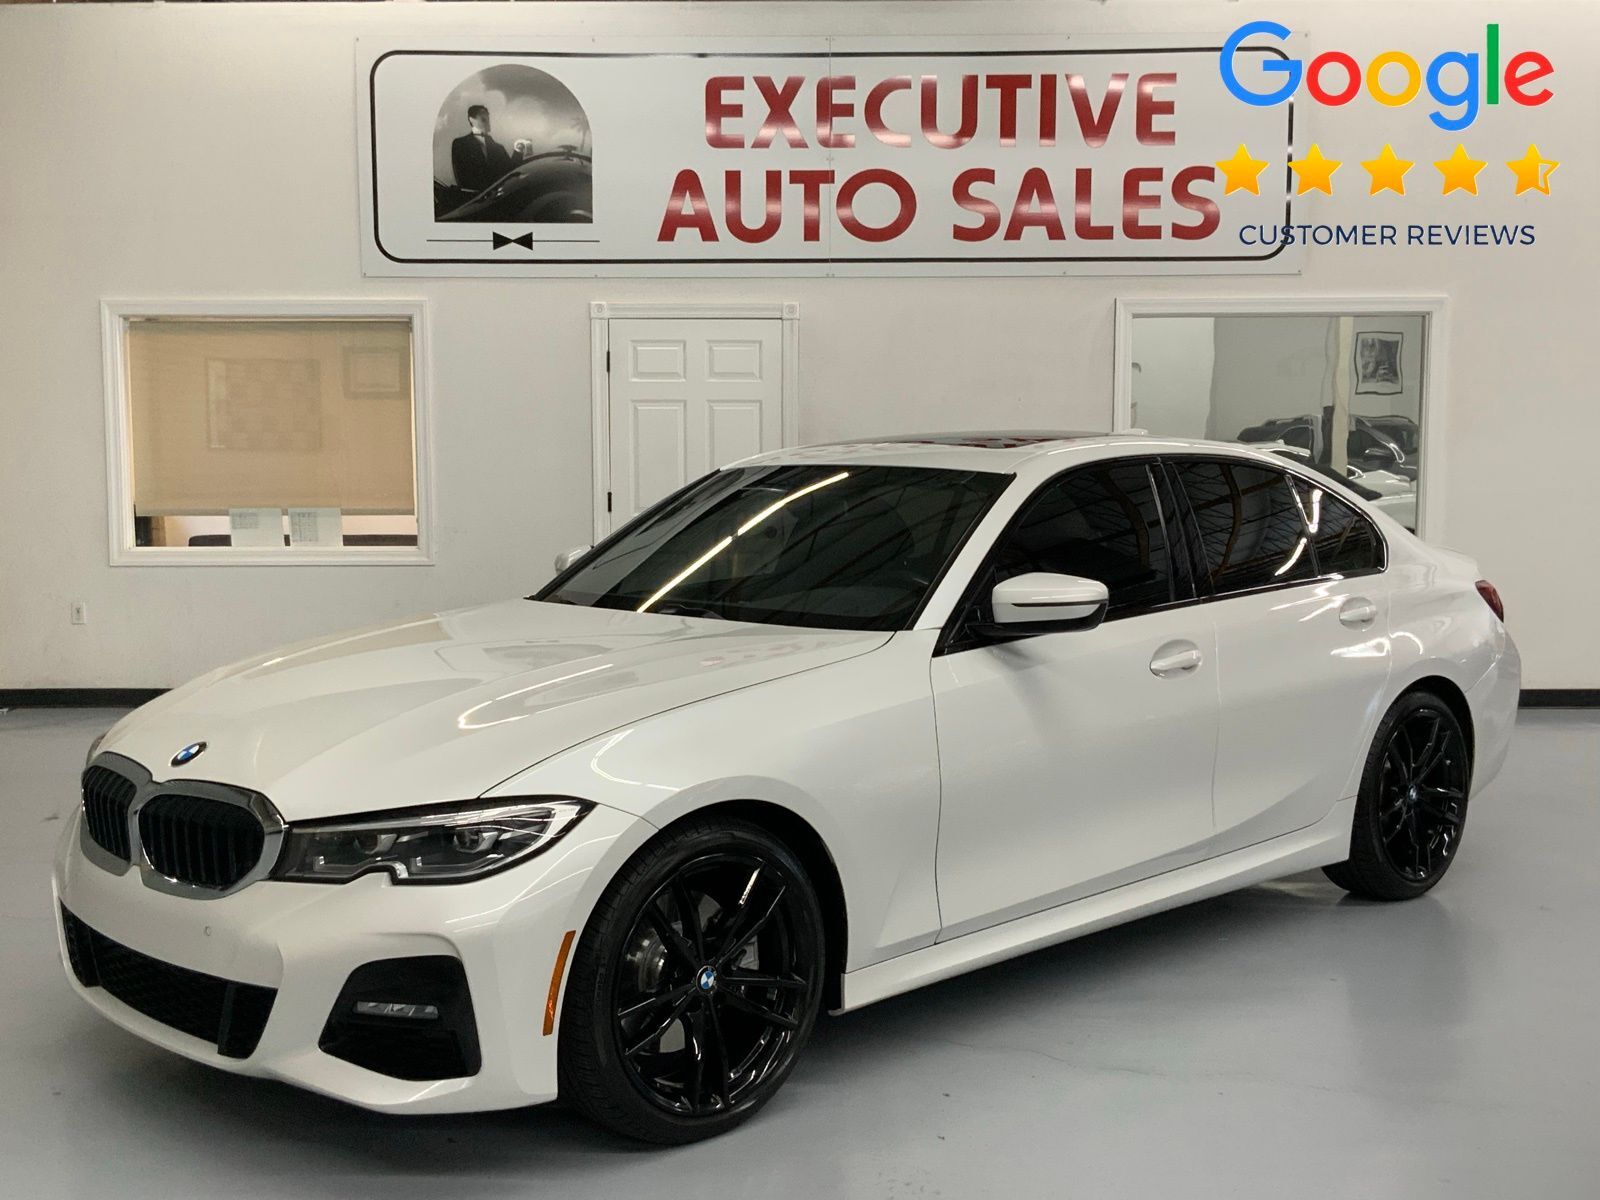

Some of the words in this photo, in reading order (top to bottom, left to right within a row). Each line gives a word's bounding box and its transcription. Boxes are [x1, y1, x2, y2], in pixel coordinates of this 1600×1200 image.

[705, 72, 1177, 149] EXECUTIVE
[657, 167, 917, 244] AUTO
[952, 165, 1221, 242] SALES
